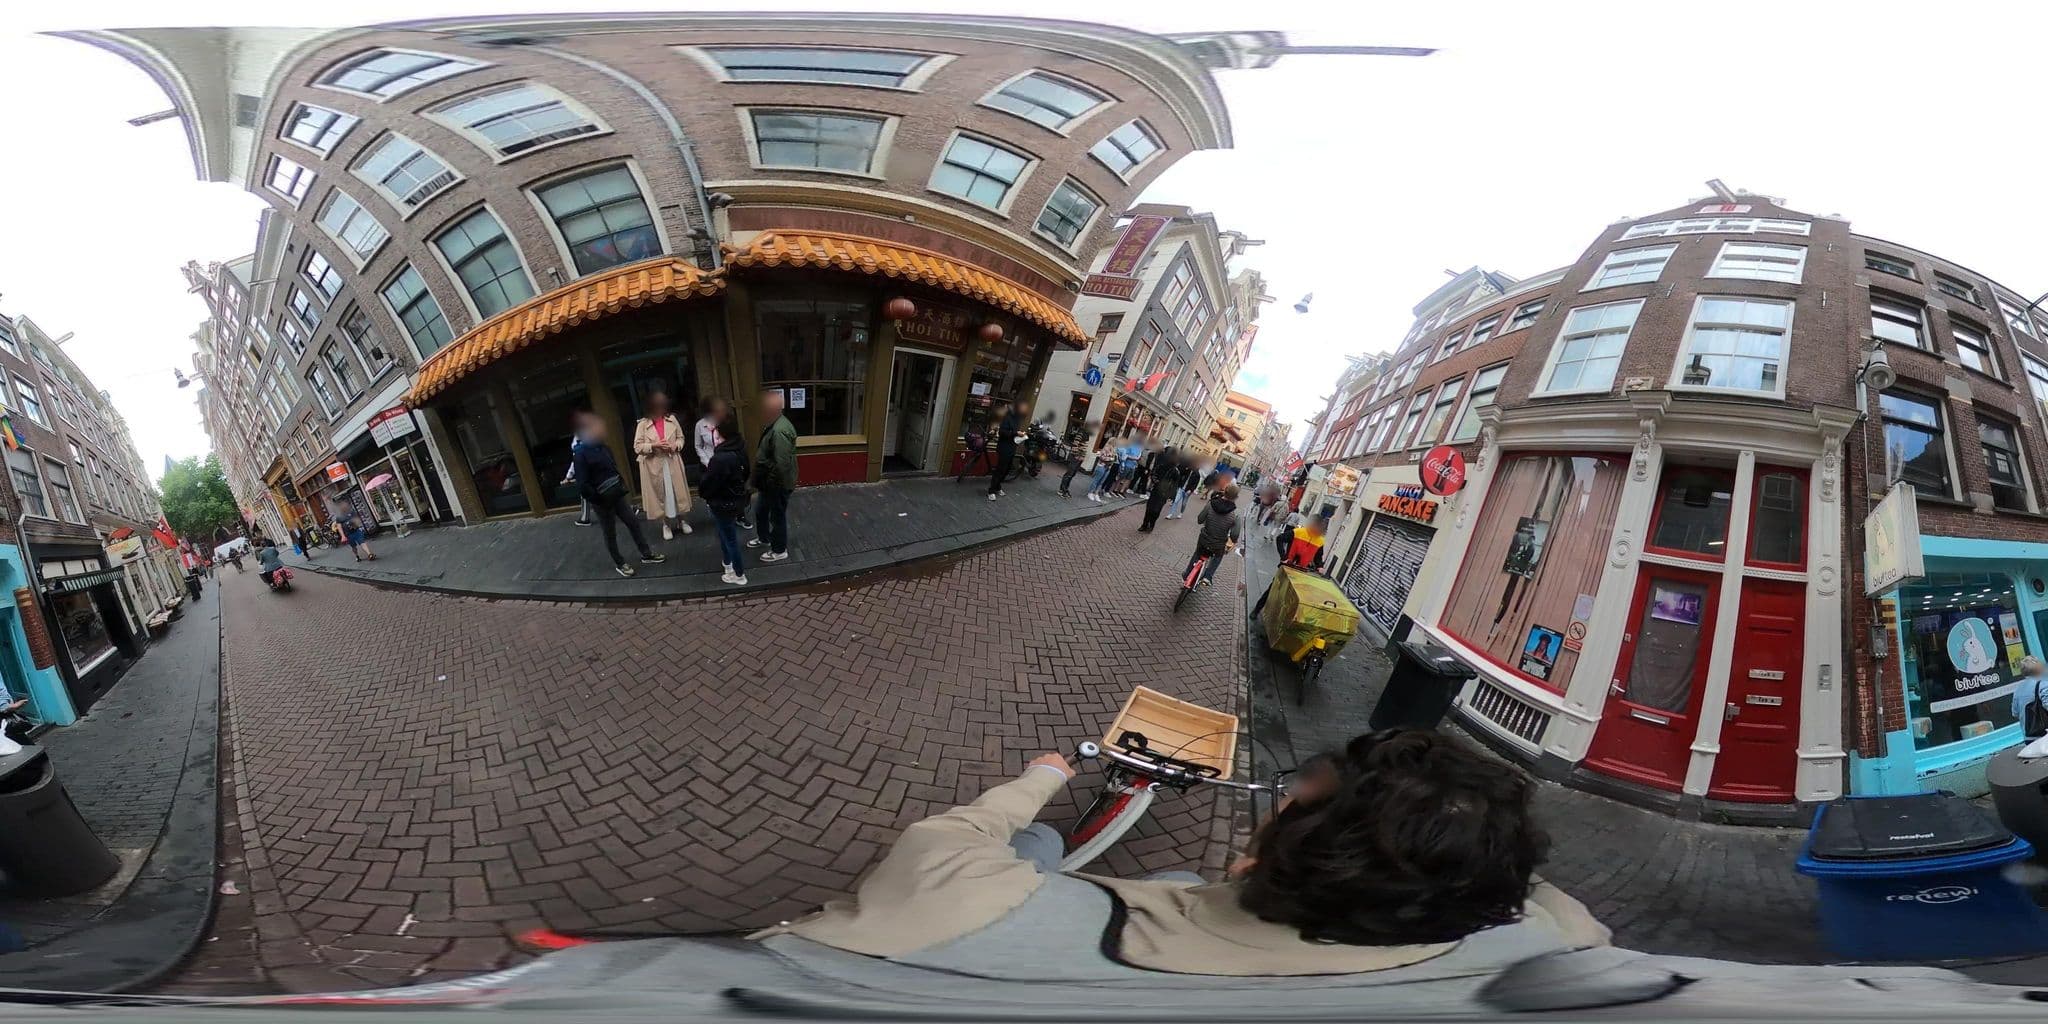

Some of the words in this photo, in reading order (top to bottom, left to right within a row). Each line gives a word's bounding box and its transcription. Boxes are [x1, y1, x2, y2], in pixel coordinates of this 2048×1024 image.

[1085, 282, 1108, 293] HOI
[1110, 285, 1133, 297] TIN
[906, 320, 932, 336] HOI
[939, 327, 960, 342] TIN
[1426, 457, 1462, 483] Coca-Cola
[1379, 494, 1437, 522] PANCAKE
[1886, 886, 1979, 902] renewi
